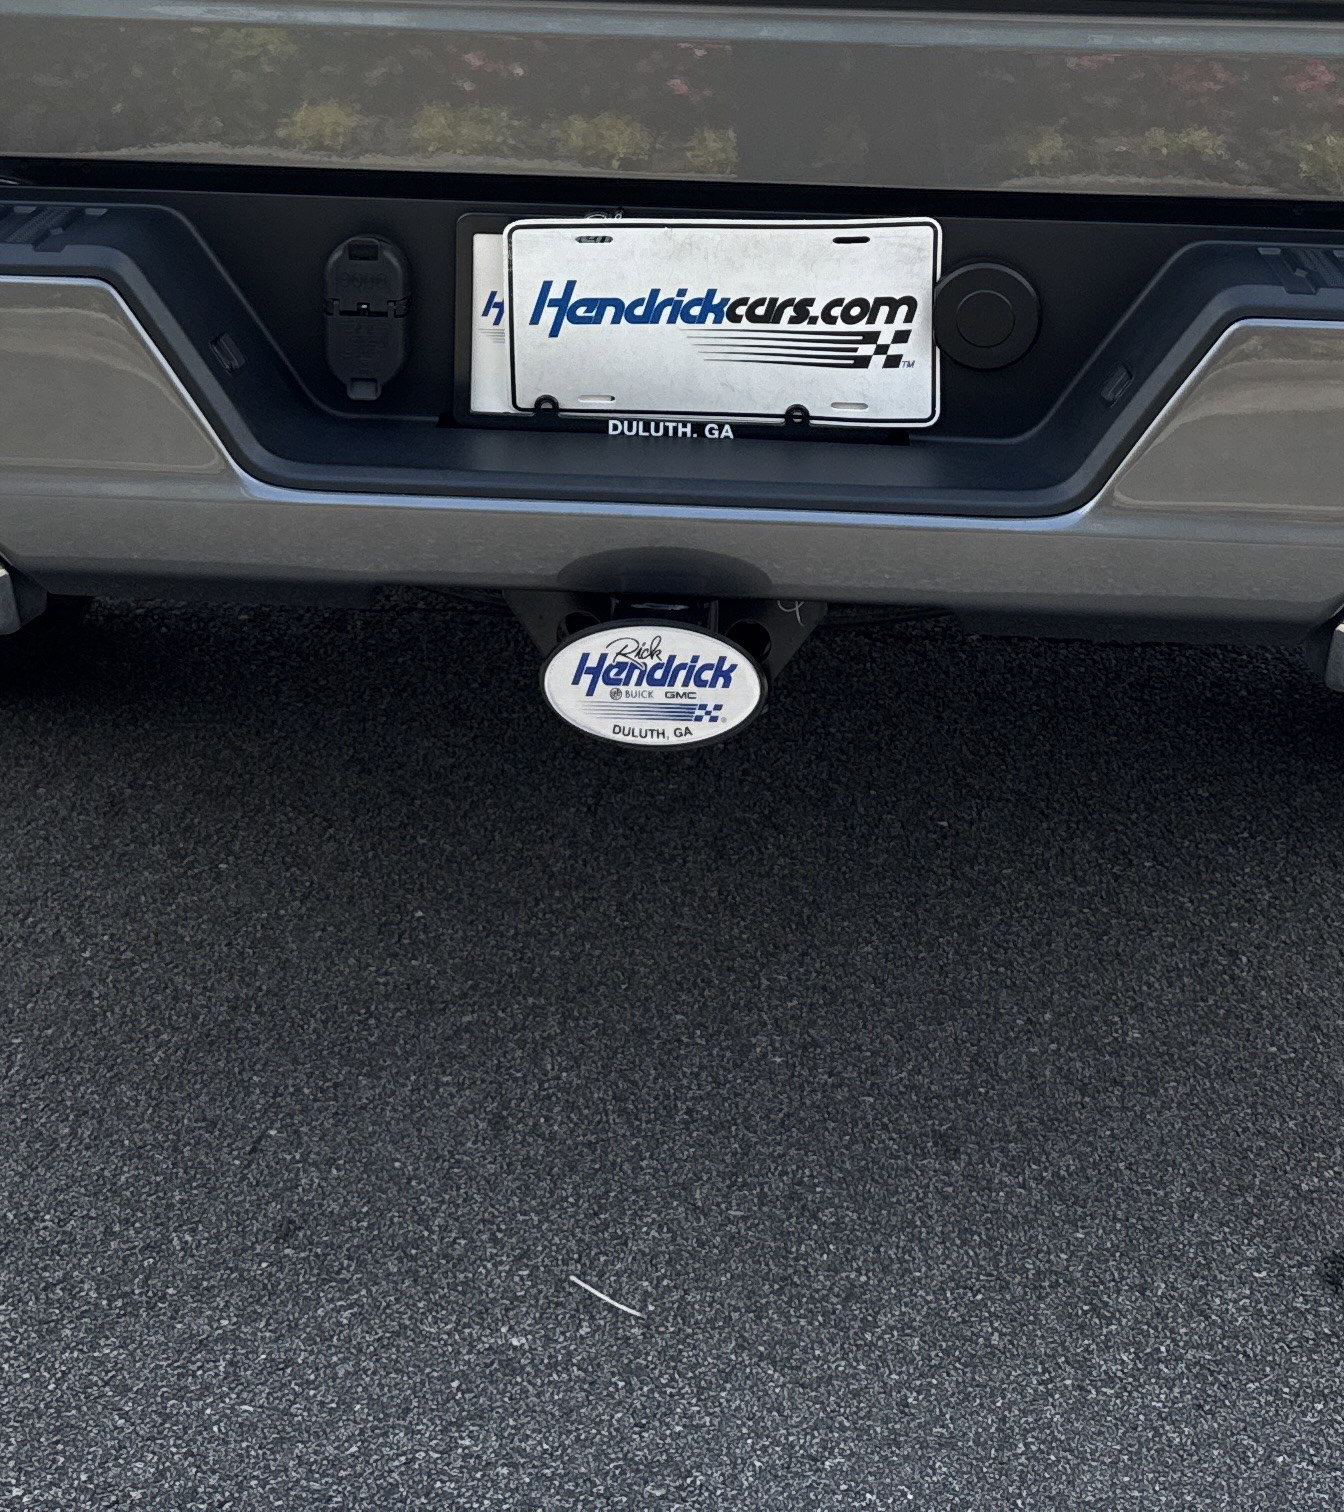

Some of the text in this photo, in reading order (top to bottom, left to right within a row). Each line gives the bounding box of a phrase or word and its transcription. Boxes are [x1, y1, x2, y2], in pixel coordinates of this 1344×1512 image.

[529, 280, 918, 338] Hendrickcars.com
[704, 423, 734, 439] GA
[606, 635, 663, 664] Rick
[571, 652, 739, 697] Hendrick
[625, 689, 697, 700] BUICK GMC
[673, 726, 693, 738] GA
